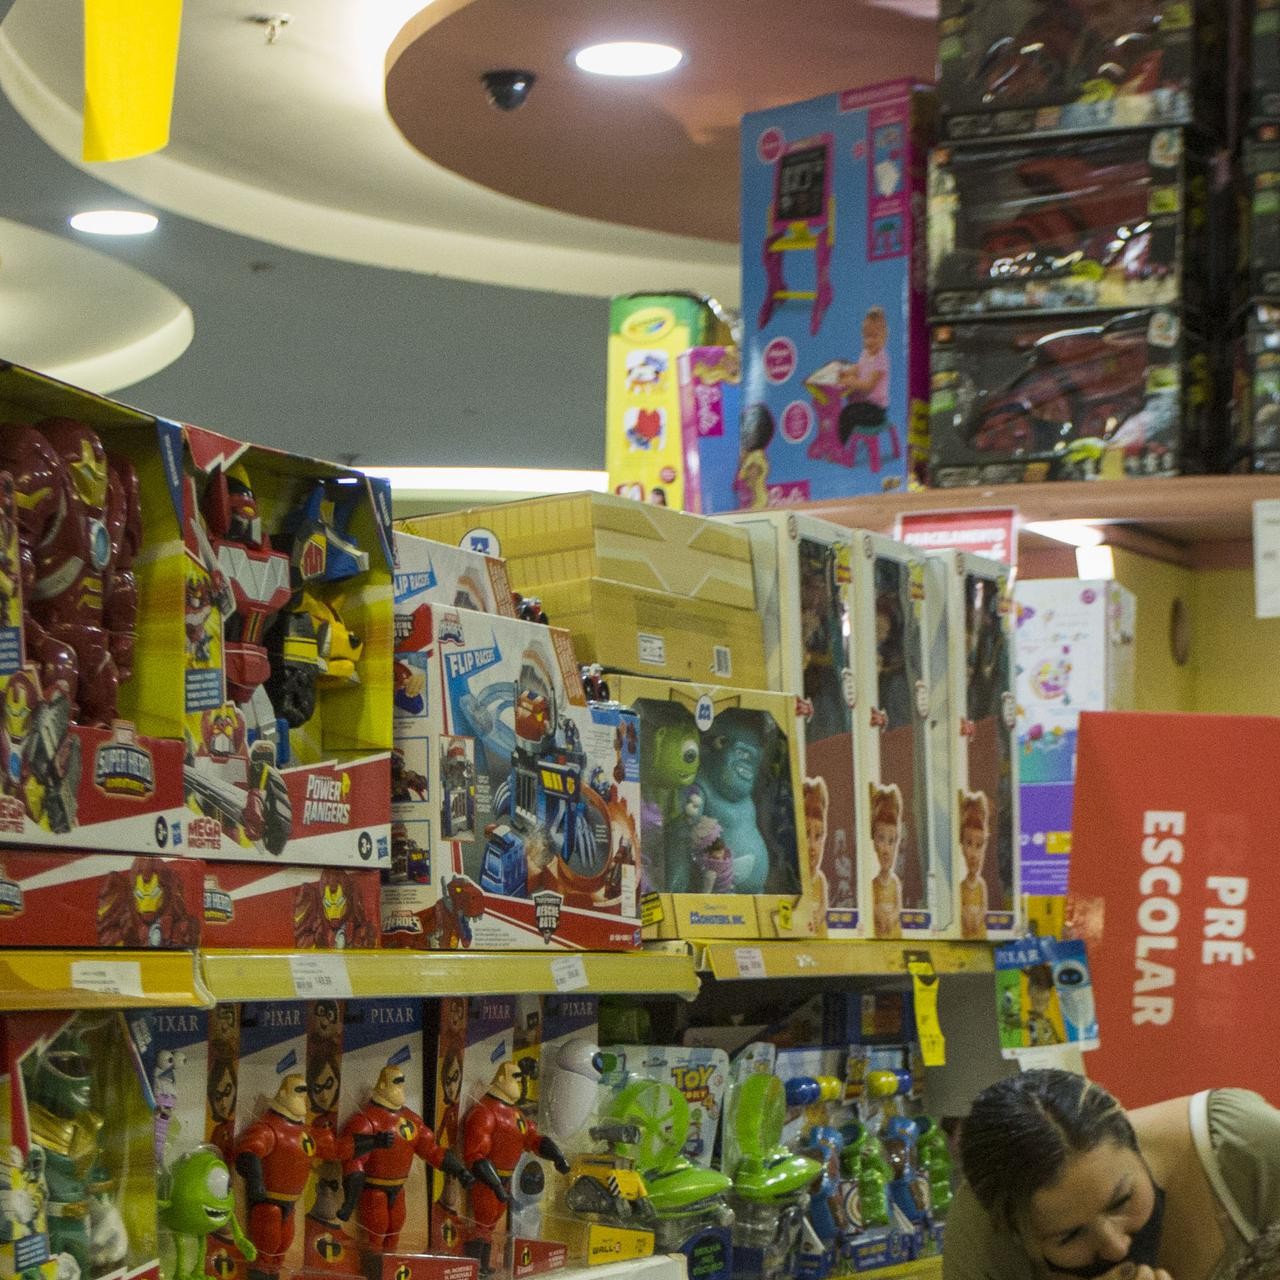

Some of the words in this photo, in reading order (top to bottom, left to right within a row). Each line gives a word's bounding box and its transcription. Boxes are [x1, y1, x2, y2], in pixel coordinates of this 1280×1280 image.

[449, 651, 476, 679] FLIP
[305, 774, 342, 801] POWER
[303, 799, 351, 825] RANGERS
[187, 817, 222, 837] MEGA
[1131, 810, 1186, 1026] ESCOLAR
[1201, 875, 1256, 966] PRÉ
[263, 1009, 302, 1027] PIXAR
[370, 1005, 415, 1025] PIXAR
[482, 1002, 513, 1021] PIXAR
[562, 1000, 595, 1018] PIXAR
[670, 1065, 718, 1091] TOY
